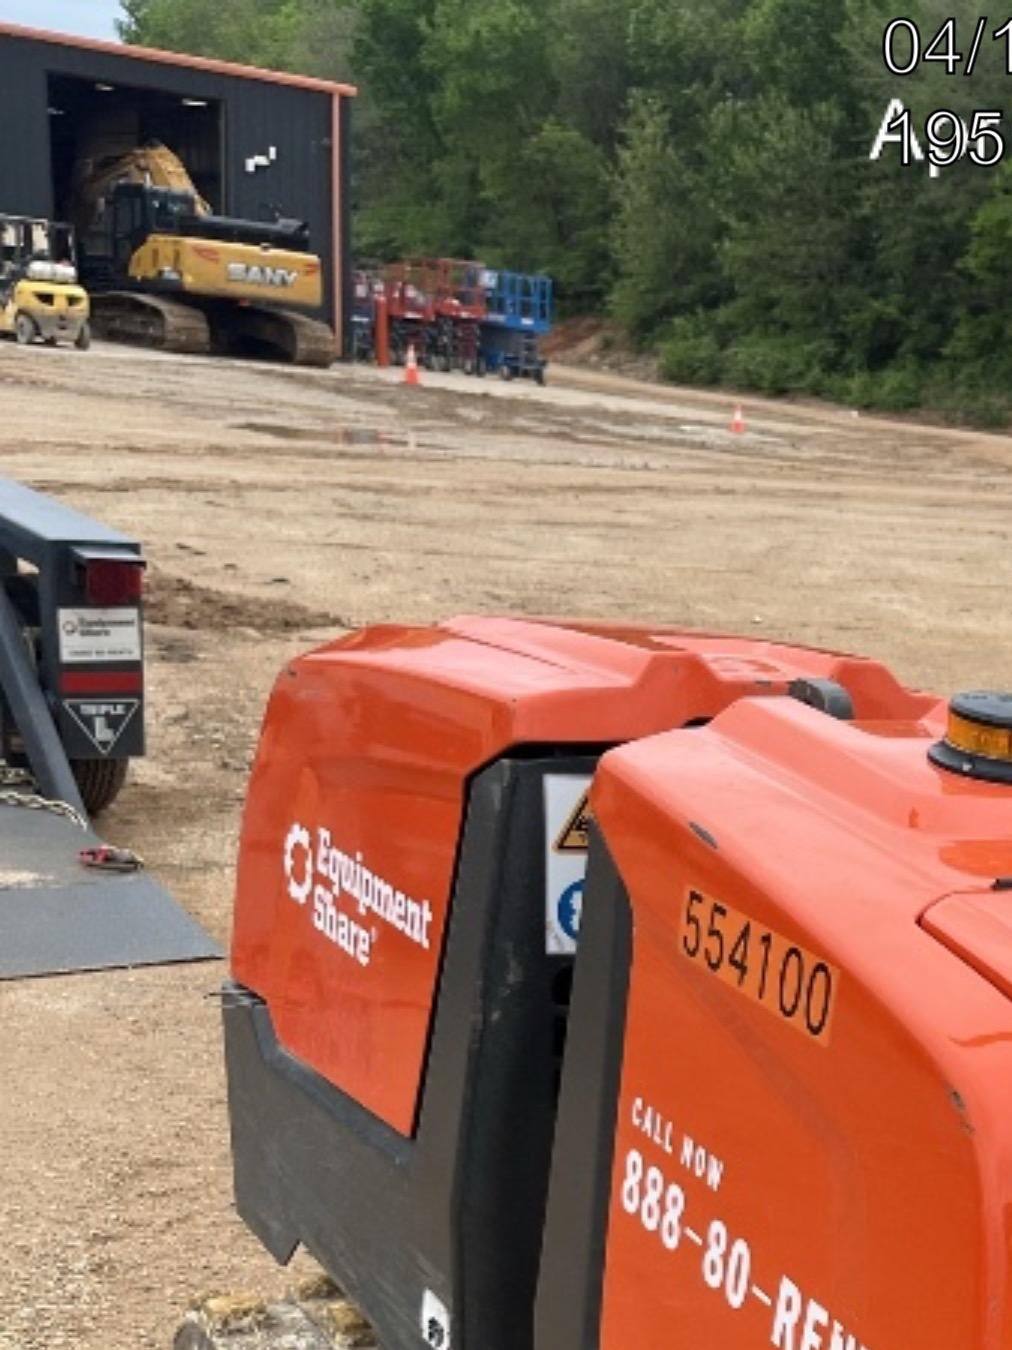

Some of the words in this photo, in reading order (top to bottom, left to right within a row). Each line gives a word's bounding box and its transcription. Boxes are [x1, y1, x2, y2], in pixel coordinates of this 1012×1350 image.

[227, 262, 298, 287] SANY
[317, 827, 432, 949] Equipment
[683, 890, 832, 1036] 554100
[632, 1098, 673, 1154] CALL
[680, 1134, 724, 1192] NOW
